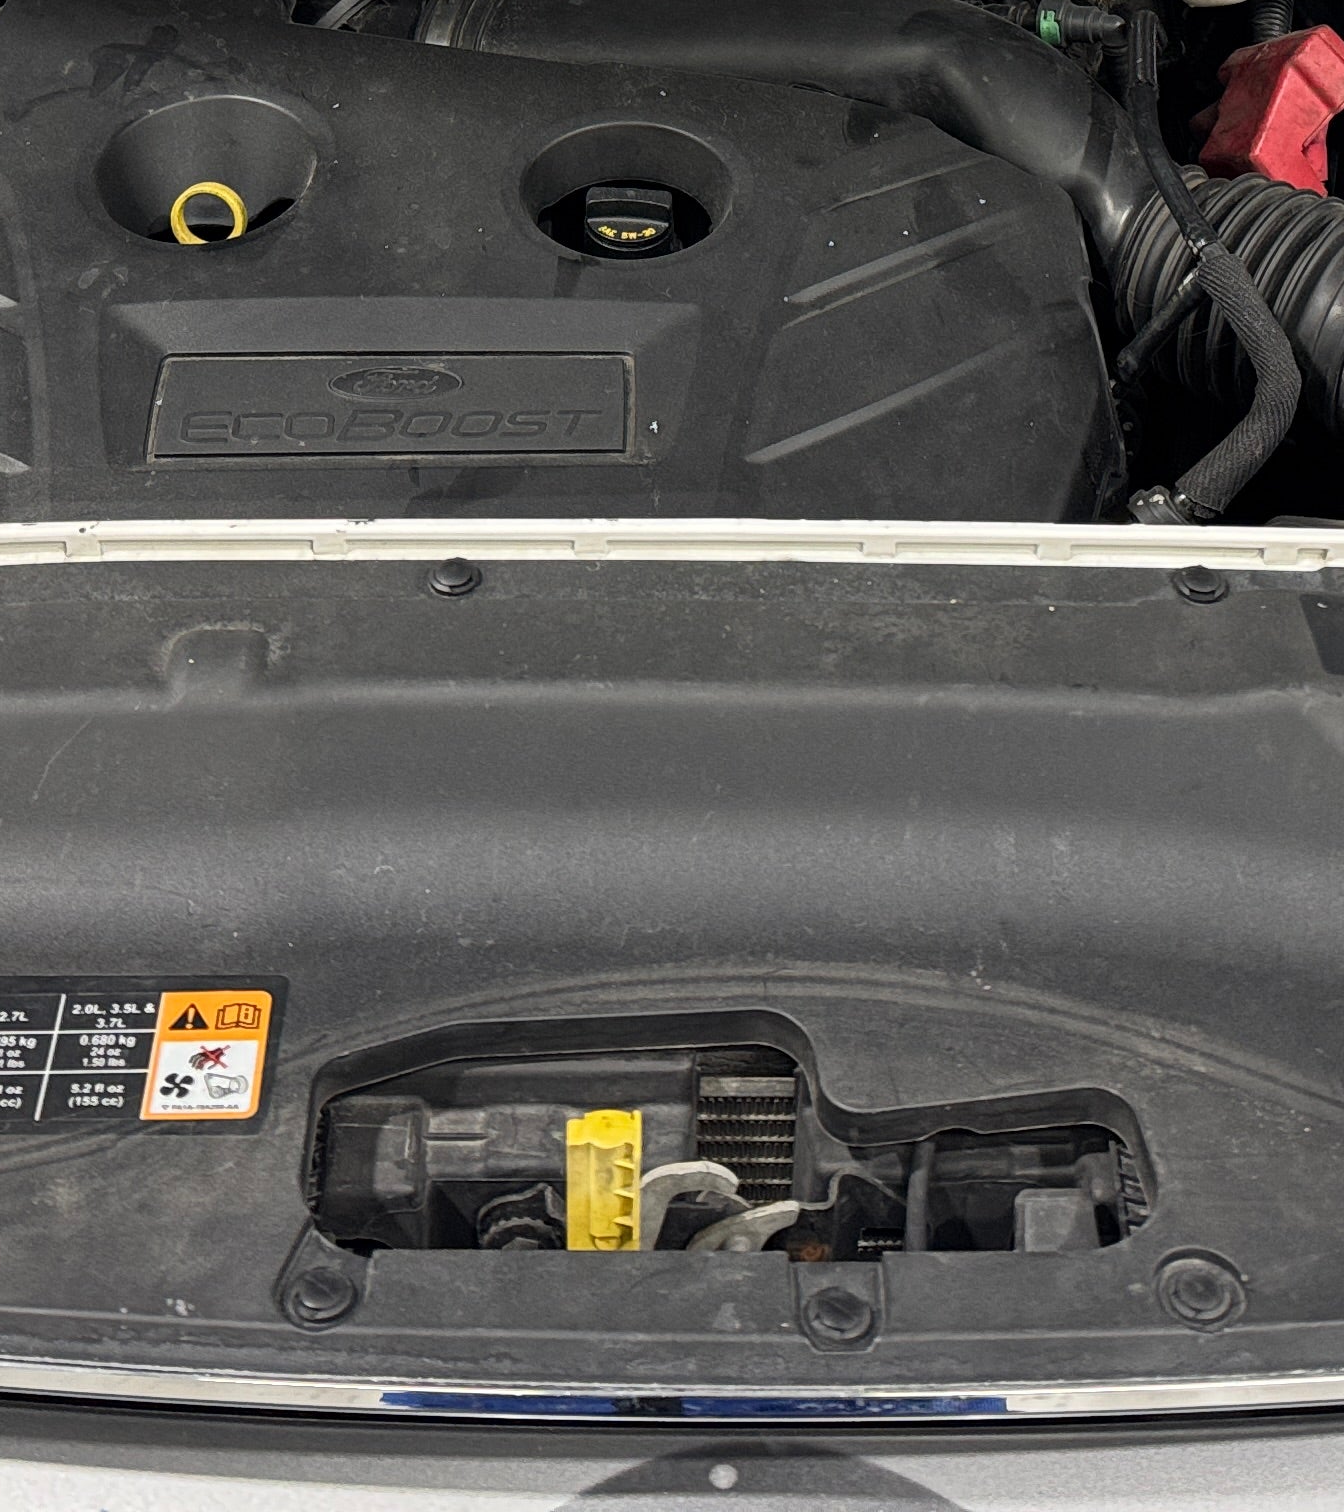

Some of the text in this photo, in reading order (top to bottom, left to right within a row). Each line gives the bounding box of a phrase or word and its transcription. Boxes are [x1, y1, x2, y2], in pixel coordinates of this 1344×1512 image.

[109, 1002, 142, 1015] 3.5L
[143, 1002, 156, 1014] &
[94, 1017, 127, 1029] 3.7L
[18, 1036, 38, 1050] kg
[79, 1034, 137, 1048] 0.680 kg
[5, 1049, 22, 1058] oz
[106, 1048, 122, 1057] oz
[5, 1086, 24, 1095] oz
[70, 1083, 93, 1094] 5.2
[106, 1084, 126, 1094] oz
[67, 1095, 125, 1109] (155 cc)
